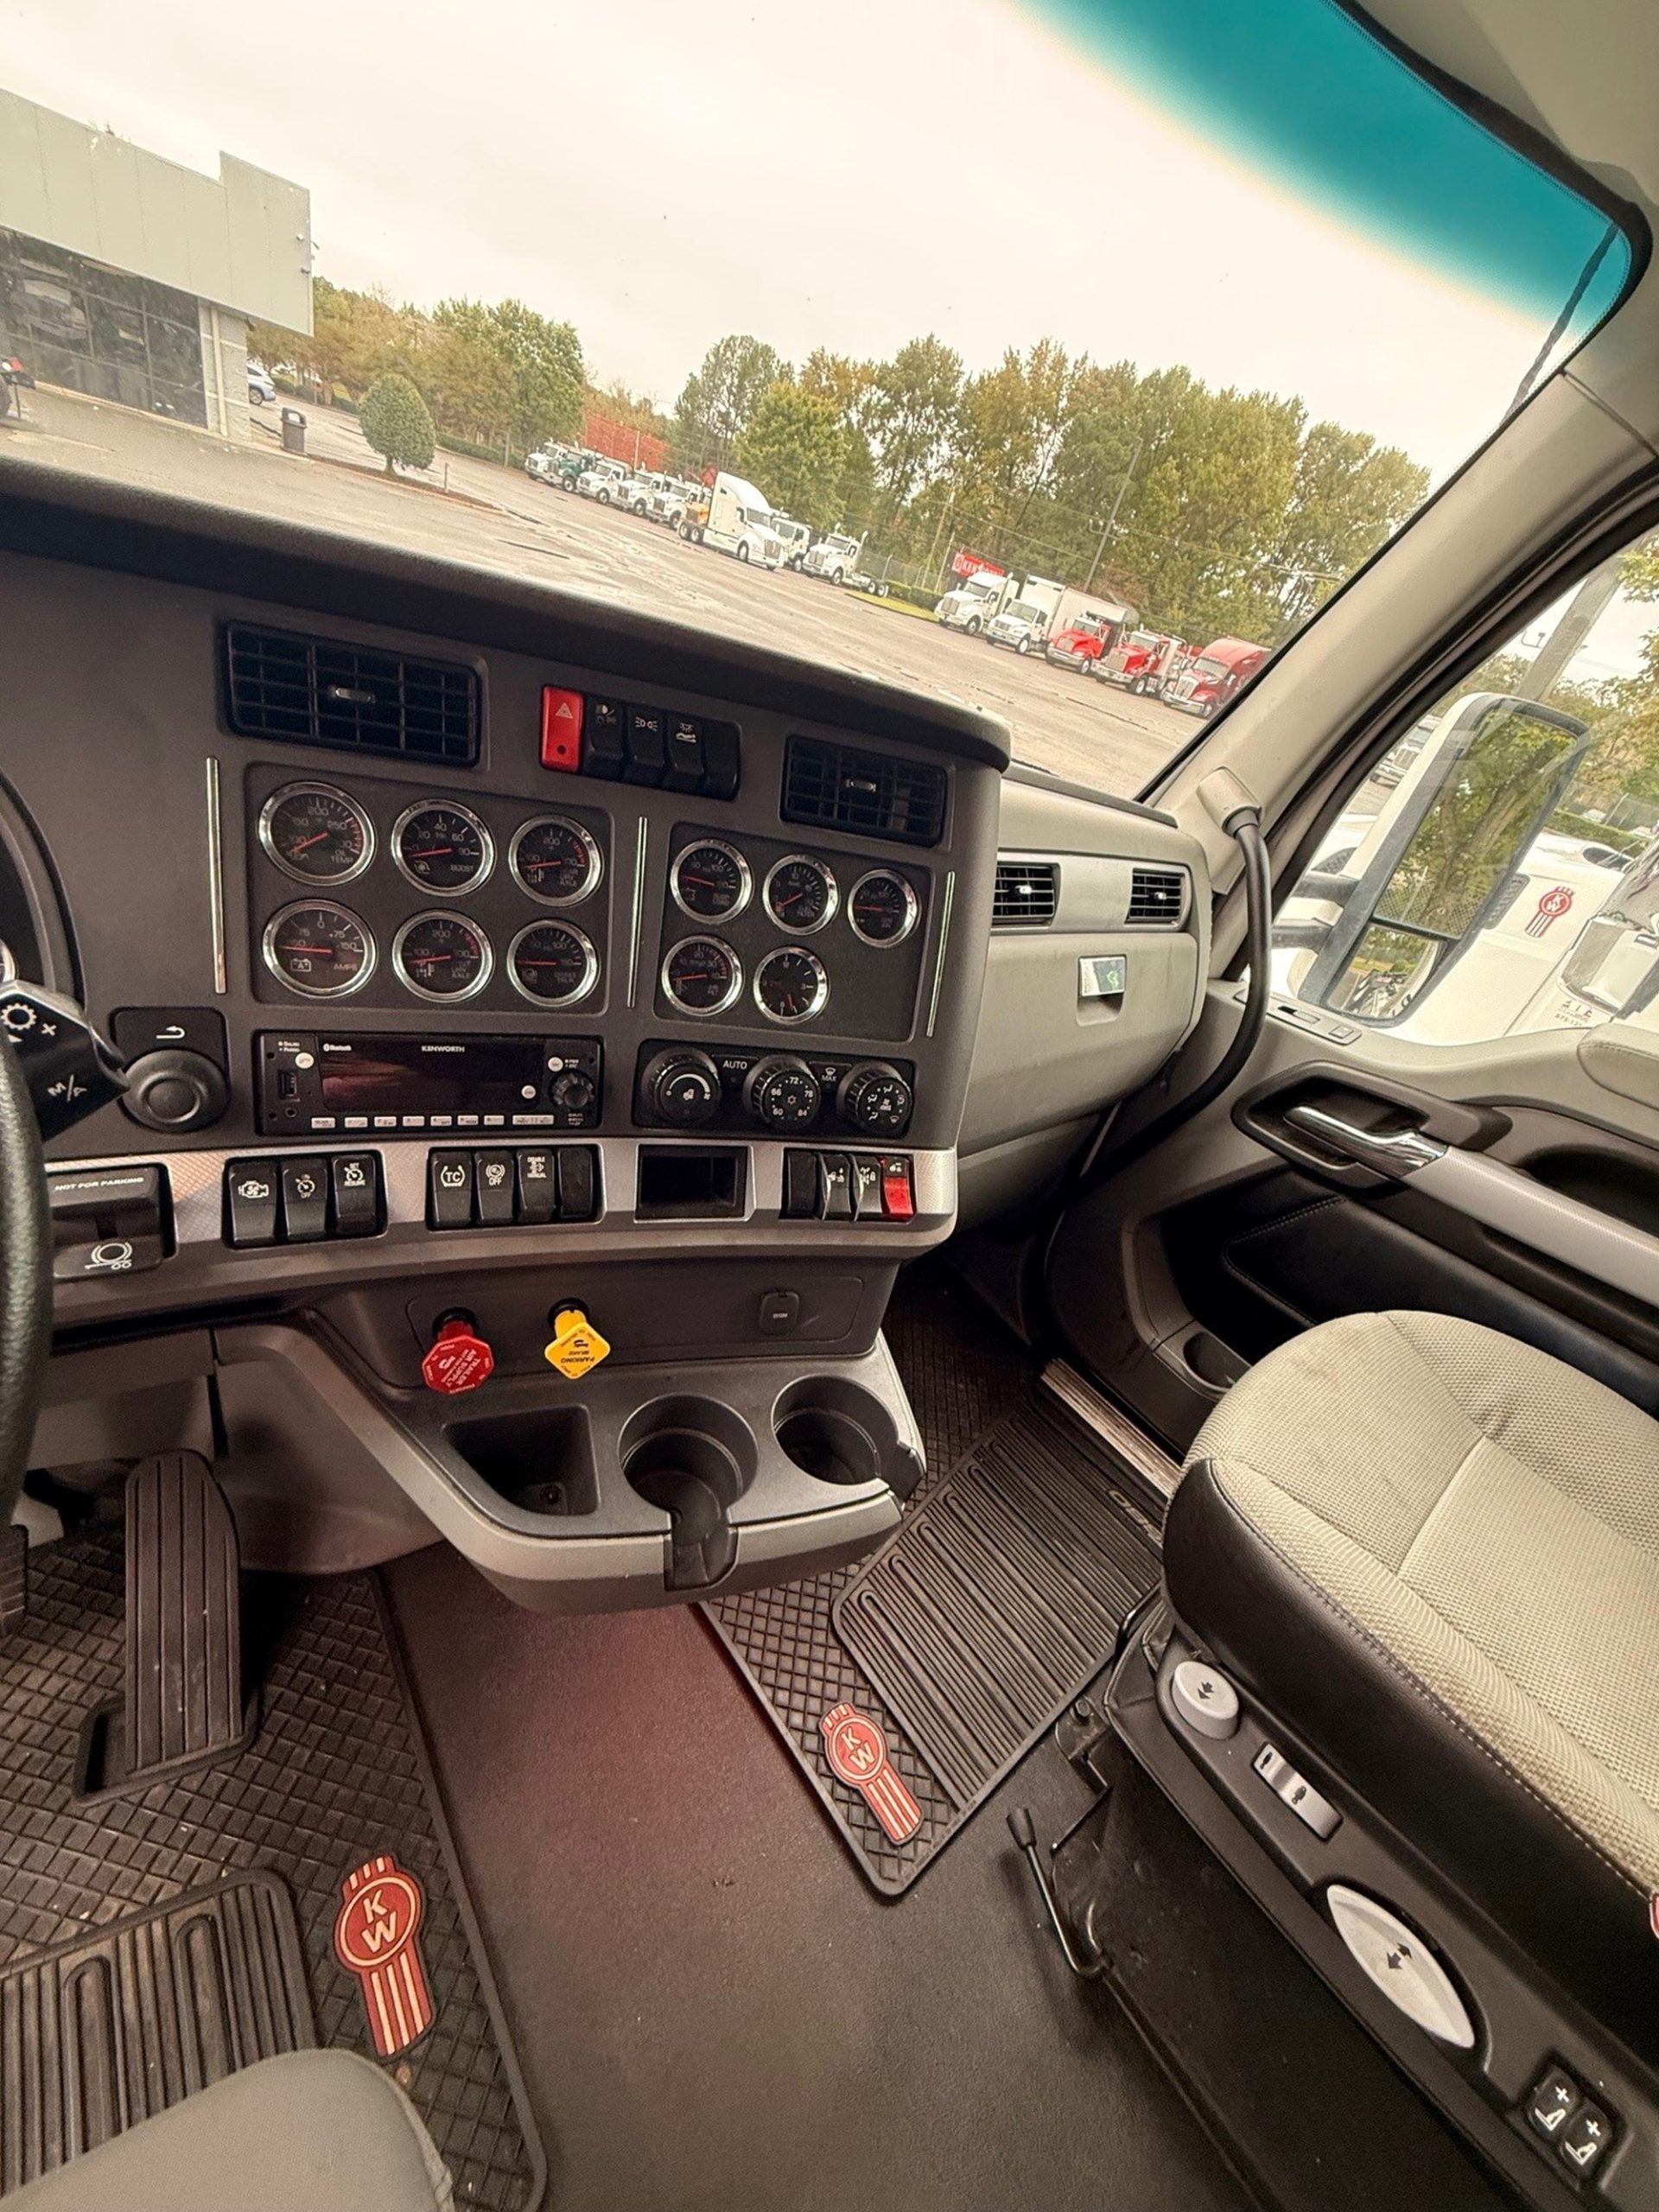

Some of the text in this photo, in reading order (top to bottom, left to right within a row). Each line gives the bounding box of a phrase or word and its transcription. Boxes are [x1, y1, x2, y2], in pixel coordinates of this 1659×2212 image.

[317, 920, 325, 929] 0
[722, 1059, 748, 1070] AUTO
[789, 1077, 799, 1085] 72
[771, 1088, 782, 1096] 66
[804, 1090, 814, 1098] 78
[772, 1108, 784, 1116] 60
[445, 1172, 461, 1182] TC
[54, 1183, 77, 1192] NOT
[100, 1177, 144, 1186] PARKING
[488, 1178, 502, 1186] OFF
[445, 1349, 477, 1389] AIR SUPPLY
[455, 1357, 481, 1385] TRAILER
